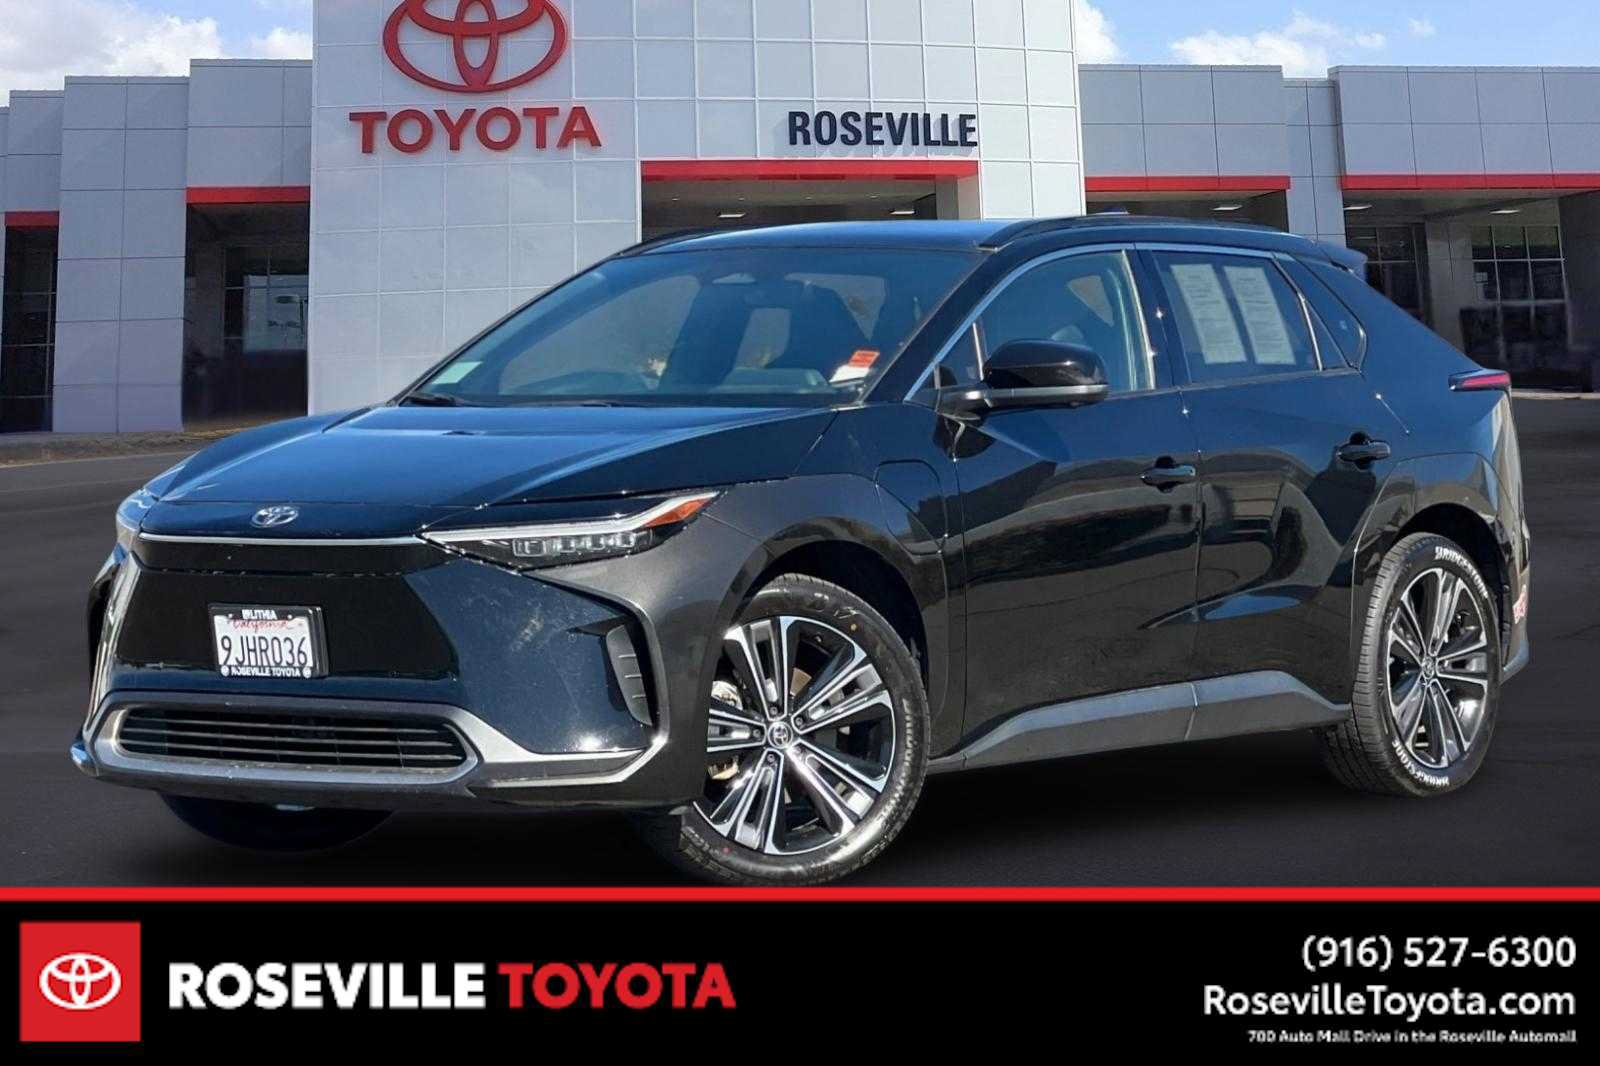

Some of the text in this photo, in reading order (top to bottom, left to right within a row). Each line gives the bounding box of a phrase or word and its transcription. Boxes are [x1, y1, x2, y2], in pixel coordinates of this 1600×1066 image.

[349, 106, 602, 153] TOYOTA
[788, 111, 978, 147] ROSEVILLE
[221, 635, 308, 667] 9JHR036
[231, 665, 301, 678] ROSEVILLE TOYOTA
